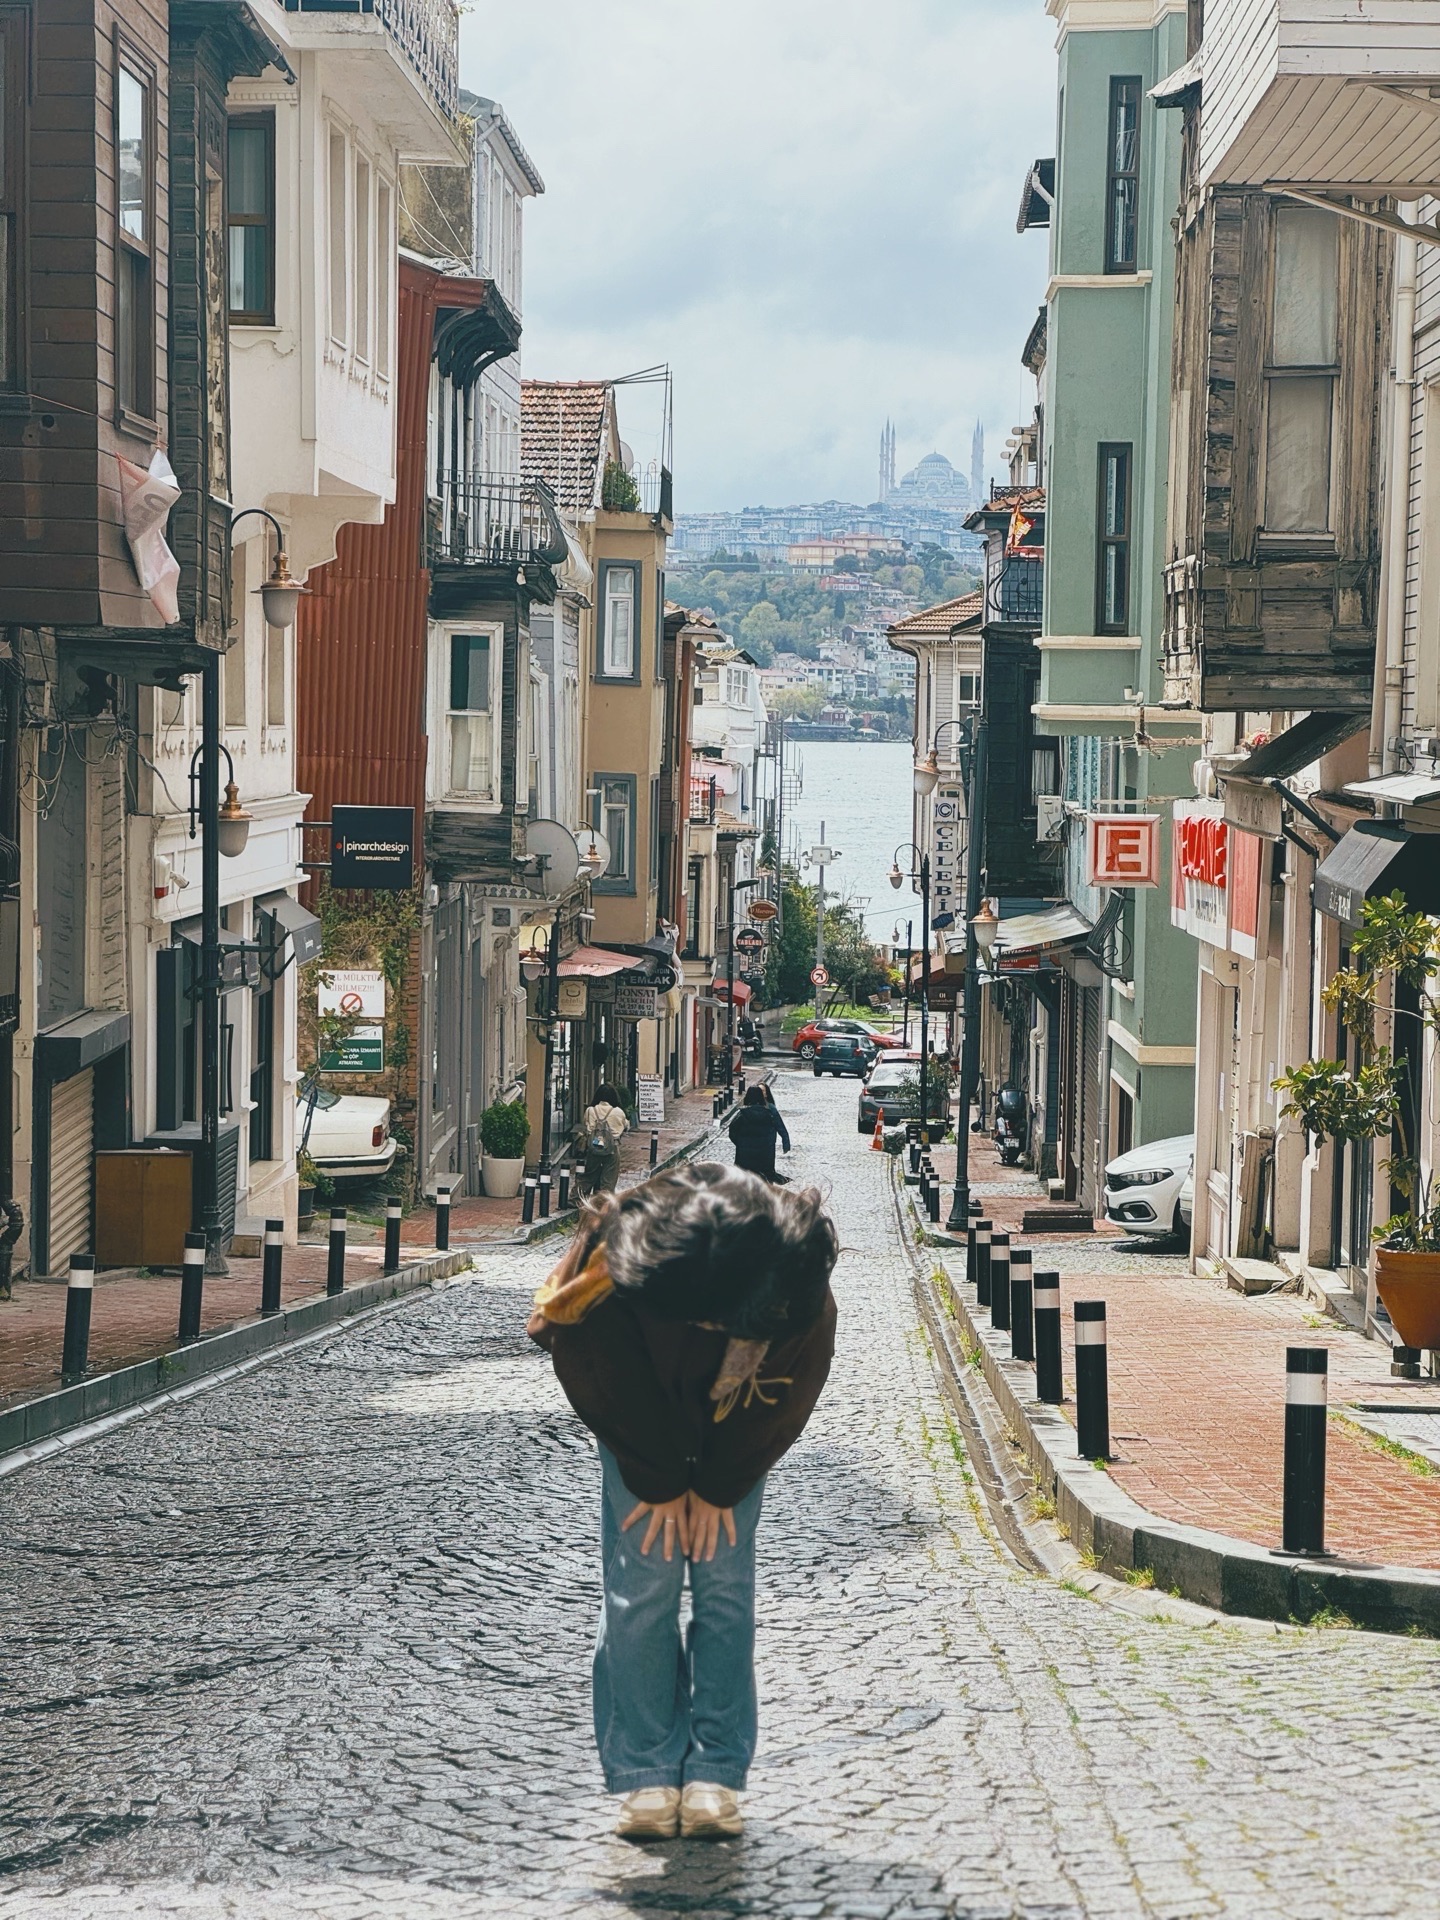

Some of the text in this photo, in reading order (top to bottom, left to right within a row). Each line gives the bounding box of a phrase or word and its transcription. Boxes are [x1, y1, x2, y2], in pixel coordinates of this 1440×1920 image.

[346, 841, 409, 854] pinarchdesign
[1106, 829, 1141, 872] E
[630, 976, 671, 985] EMLAK
